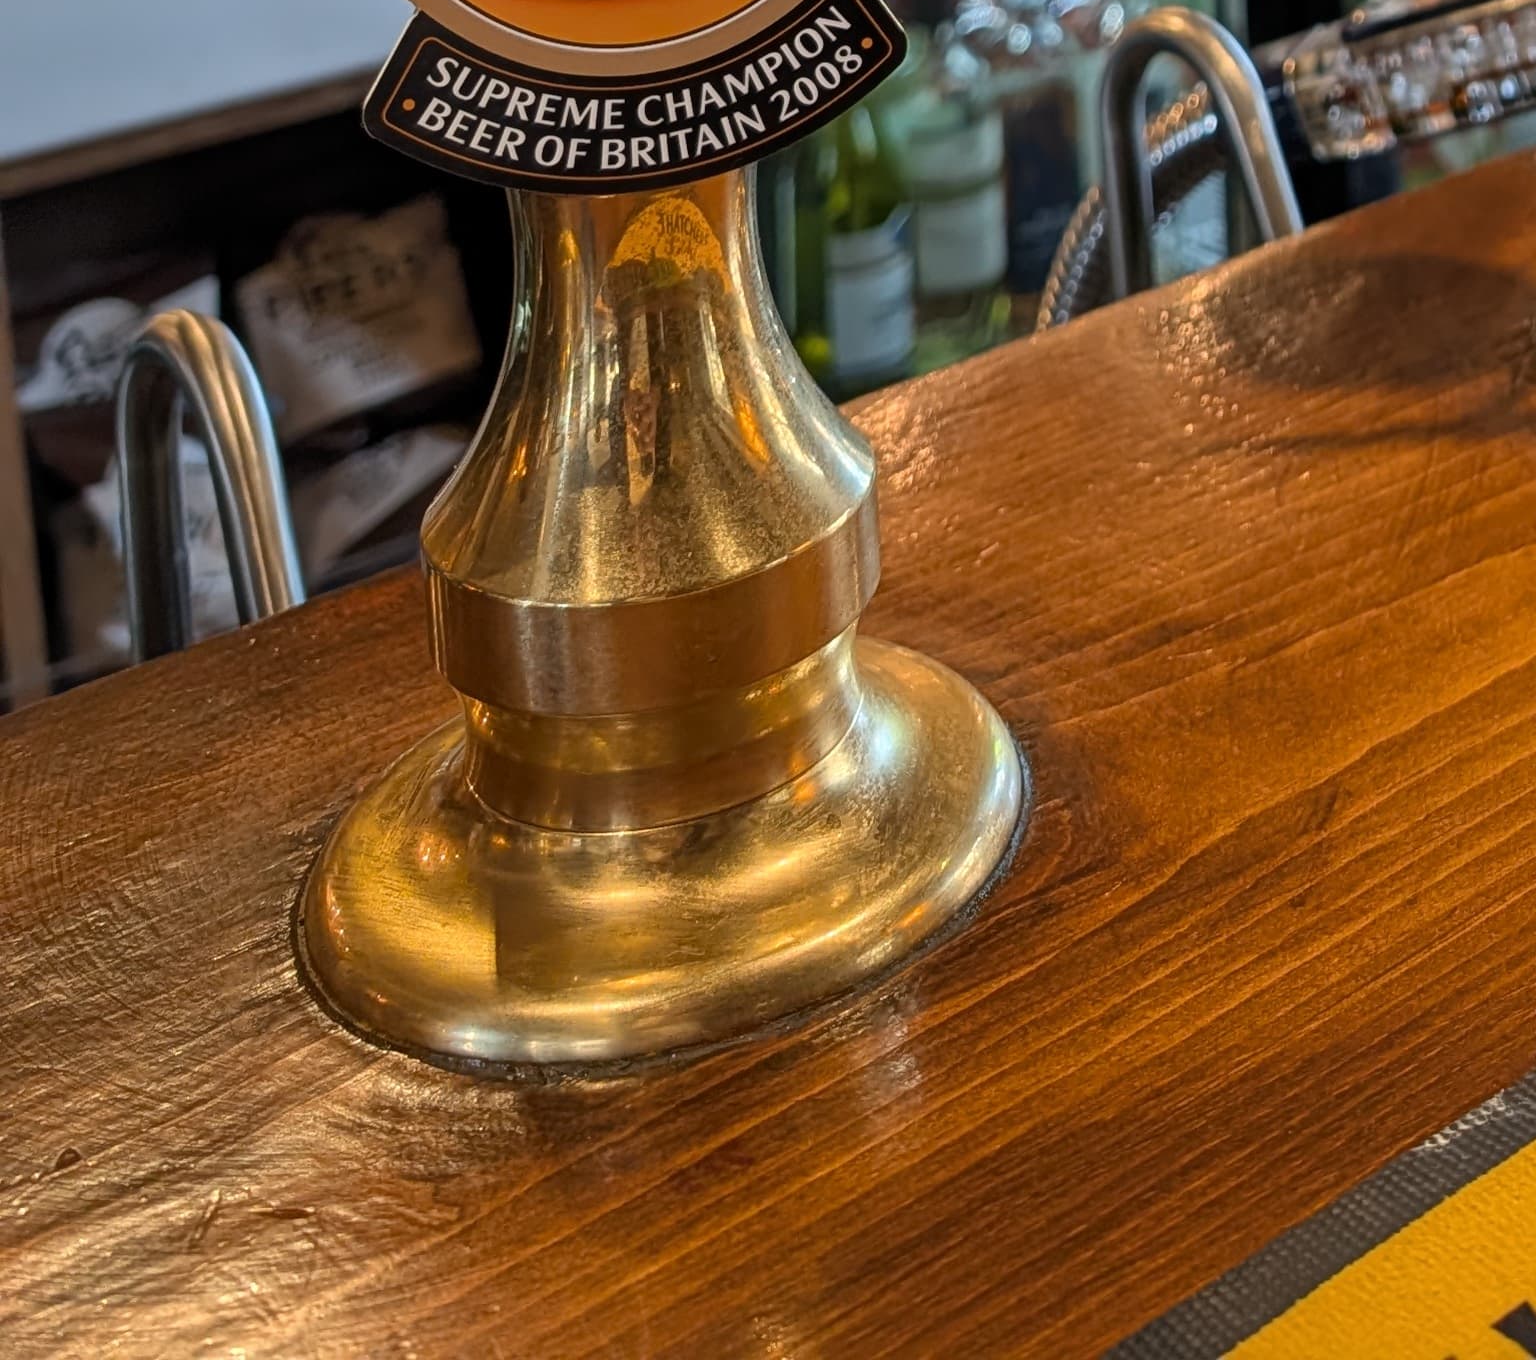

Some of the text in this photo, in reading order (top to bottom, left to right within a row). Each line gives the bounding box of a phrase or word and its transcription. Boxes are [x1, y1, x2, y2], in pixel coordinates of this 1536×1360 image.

[417, 44, 865, 171] BEER OF BRITAIN 2008
[427, 5, 853, 131] SUPREME CHAMPION
